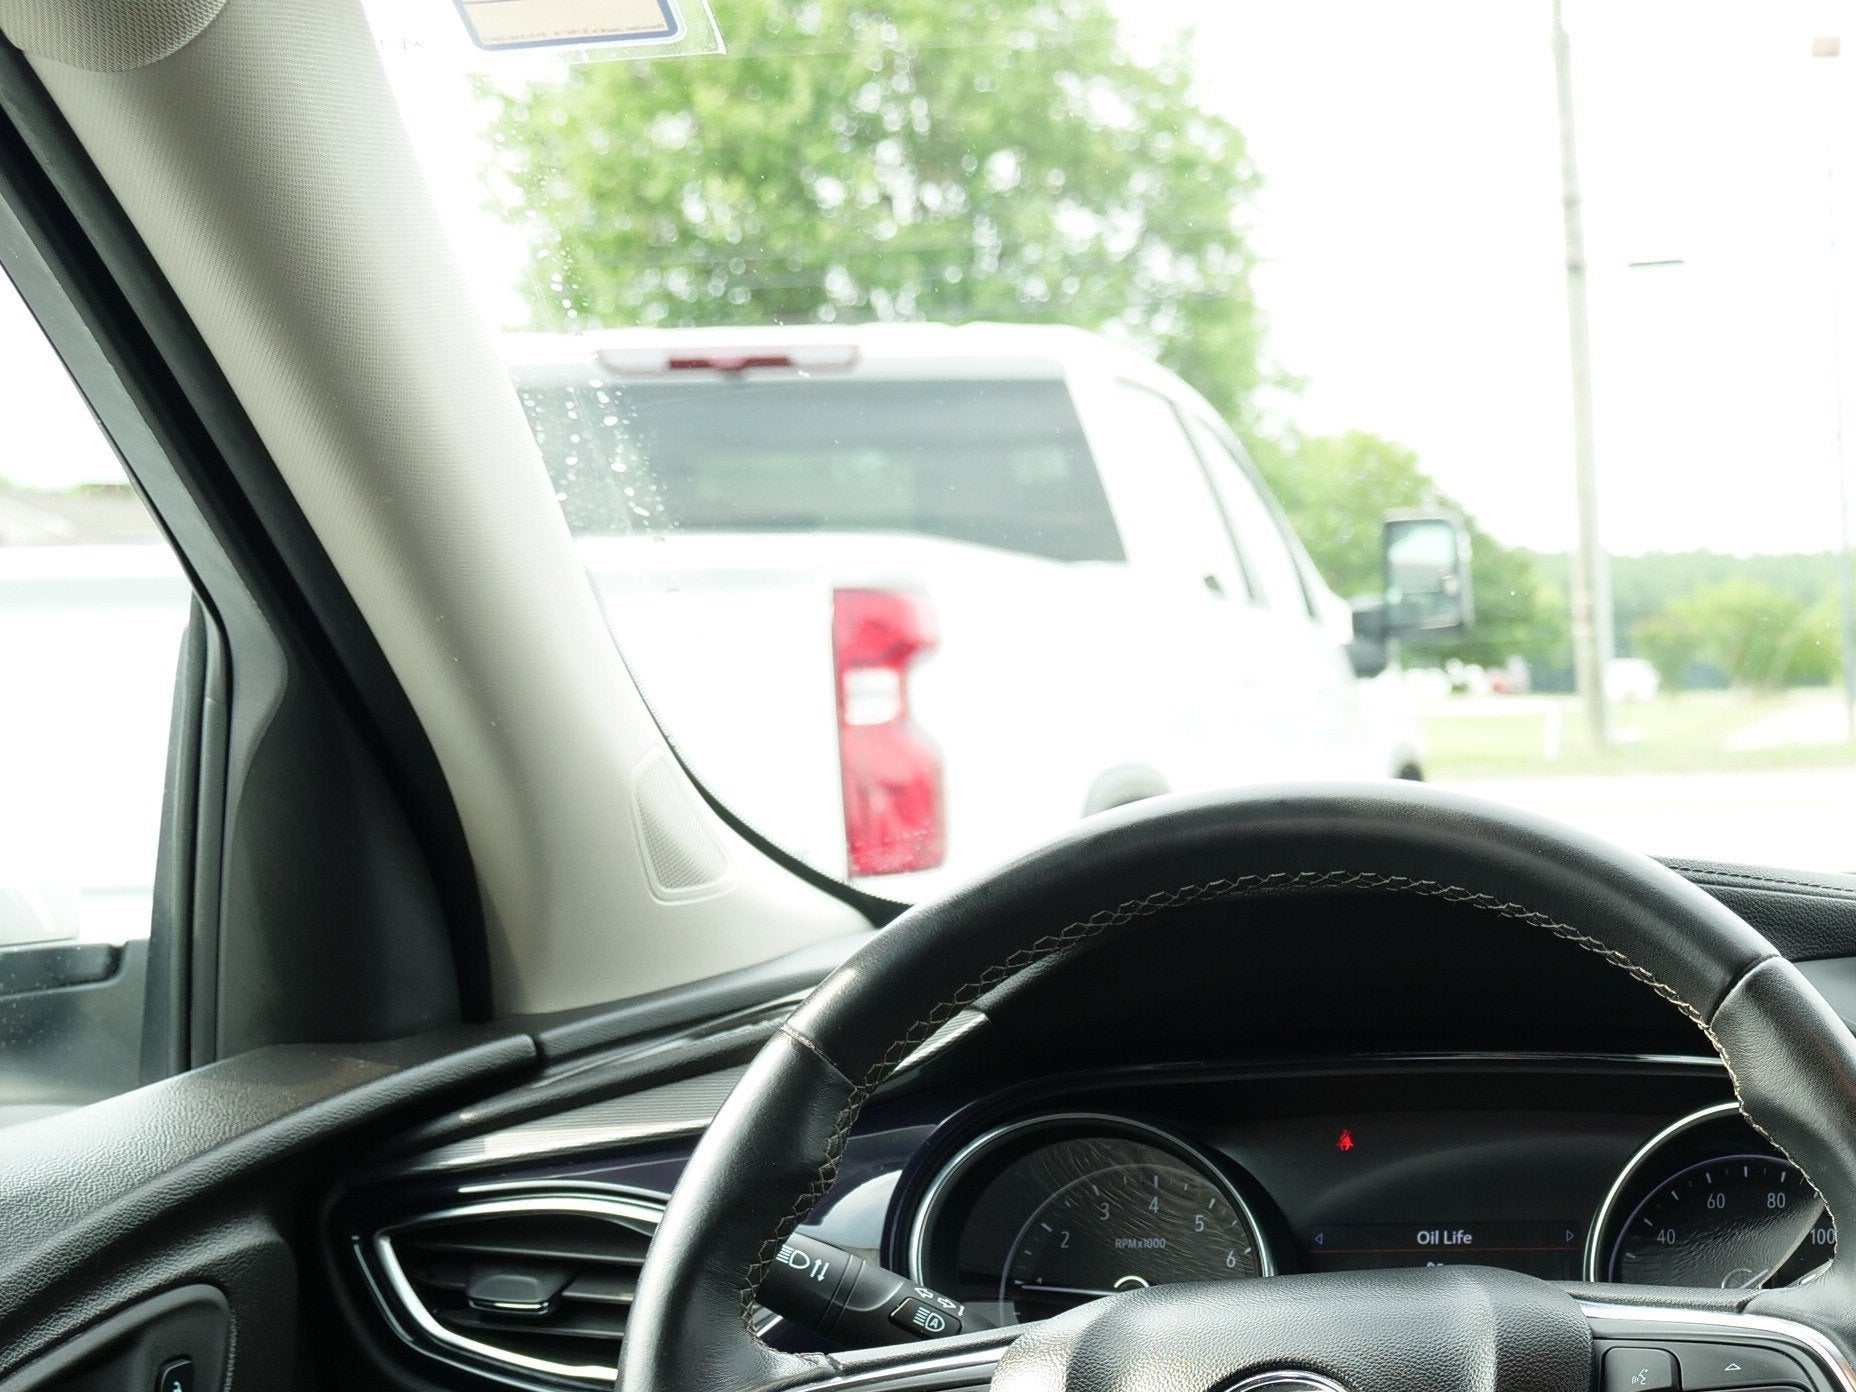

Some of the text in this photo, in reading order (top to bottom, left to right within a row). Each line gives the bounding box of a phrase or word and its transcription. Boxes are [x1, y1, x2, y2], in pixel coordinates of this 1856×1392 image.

[1148, 1196, 1159, 1214] 4
[1707, 1193, 1726, 1210] 60
[1767, 1192, 1786, 1210] 80
[1100, 1202, 1110, 1221] 3
[1195, 1215, 1205, 1233] 5
[1060, 1231, 1070, 1249] 2
[1416, 1229, 1473, 1245] Oil Life
[1657, 1228, 1676, 1245] 40
[1811, 1228, 1836, 1245] 100
[1226, 1251, 1237, 1268] 6
